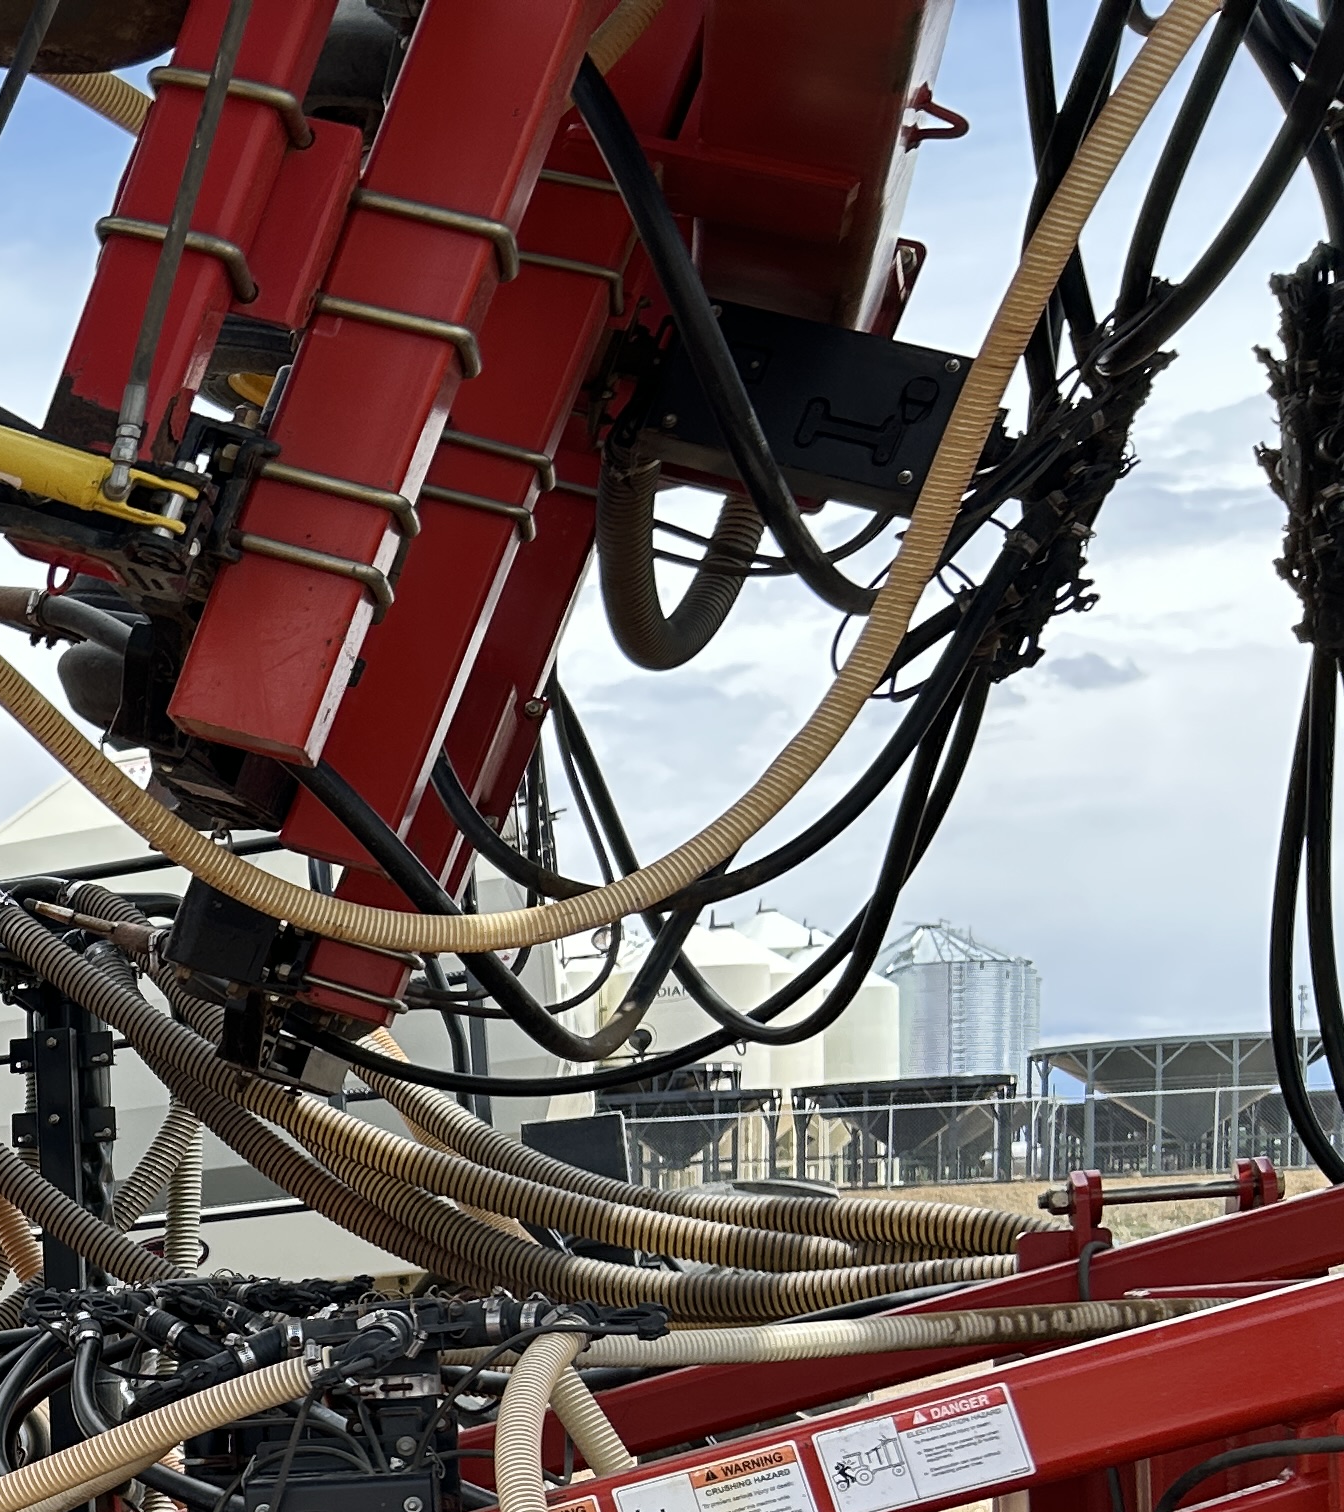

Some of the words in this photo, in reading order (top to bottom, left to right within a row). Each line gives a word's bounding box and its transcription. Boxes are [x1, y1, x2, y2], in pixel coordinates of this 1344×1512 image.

[930, 1393, 989, 1420] DANGER
[906, 1417, 970, 1439] ELECTROCUTION
[971, 1407, 1003, 1421] HAZARD
[721, 1450, 783, 1478] WARNING
[705, 1478, 752, 1497] CRUSHING
[754, 1467, 790, 1484] HAZARD
